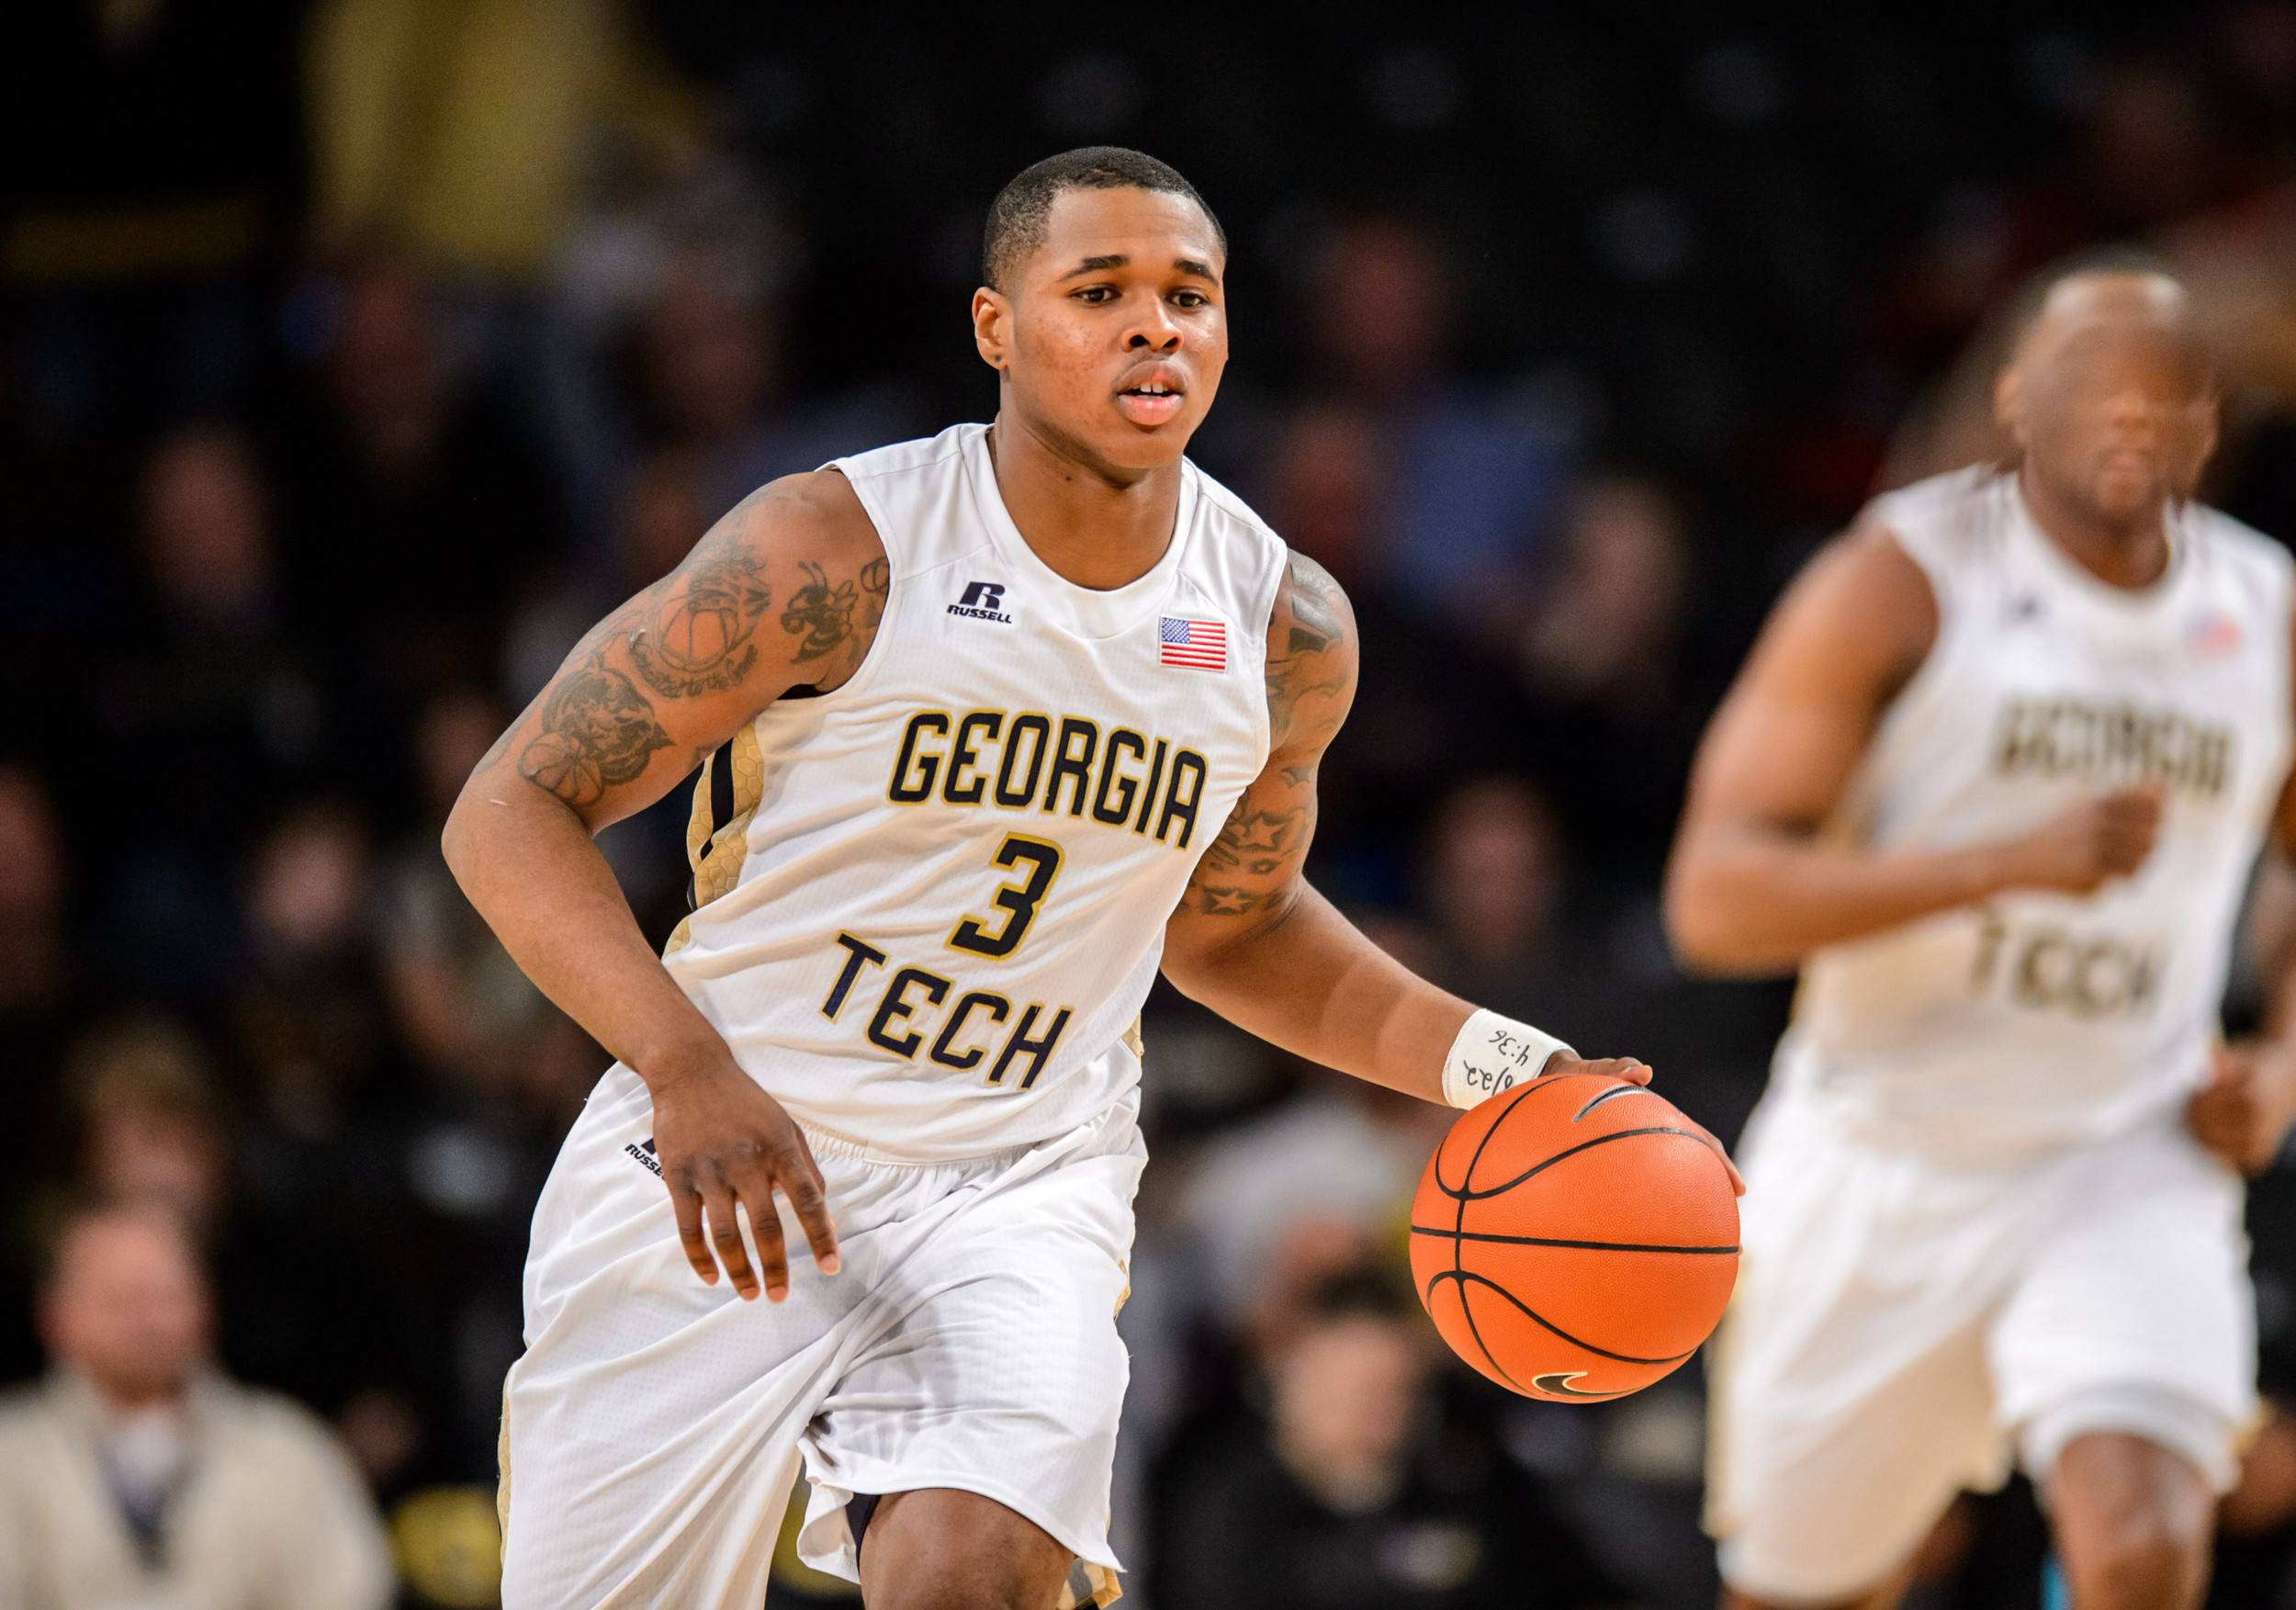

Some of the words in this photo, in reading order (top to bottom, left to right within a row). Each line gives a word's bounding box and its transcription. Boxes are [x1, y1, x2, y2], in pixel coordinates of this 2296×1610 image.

[946, 604, 1012, 625] RUSSELL
[886, 706, 1209, 851] GEORGIA
[943, 831, 1066, 961] 3
[817, 929, 1075, 1091] TECH
[1489, 1030, 1530, 1067] 4:36
[625, 1143, 664, 1179] RUSSE
